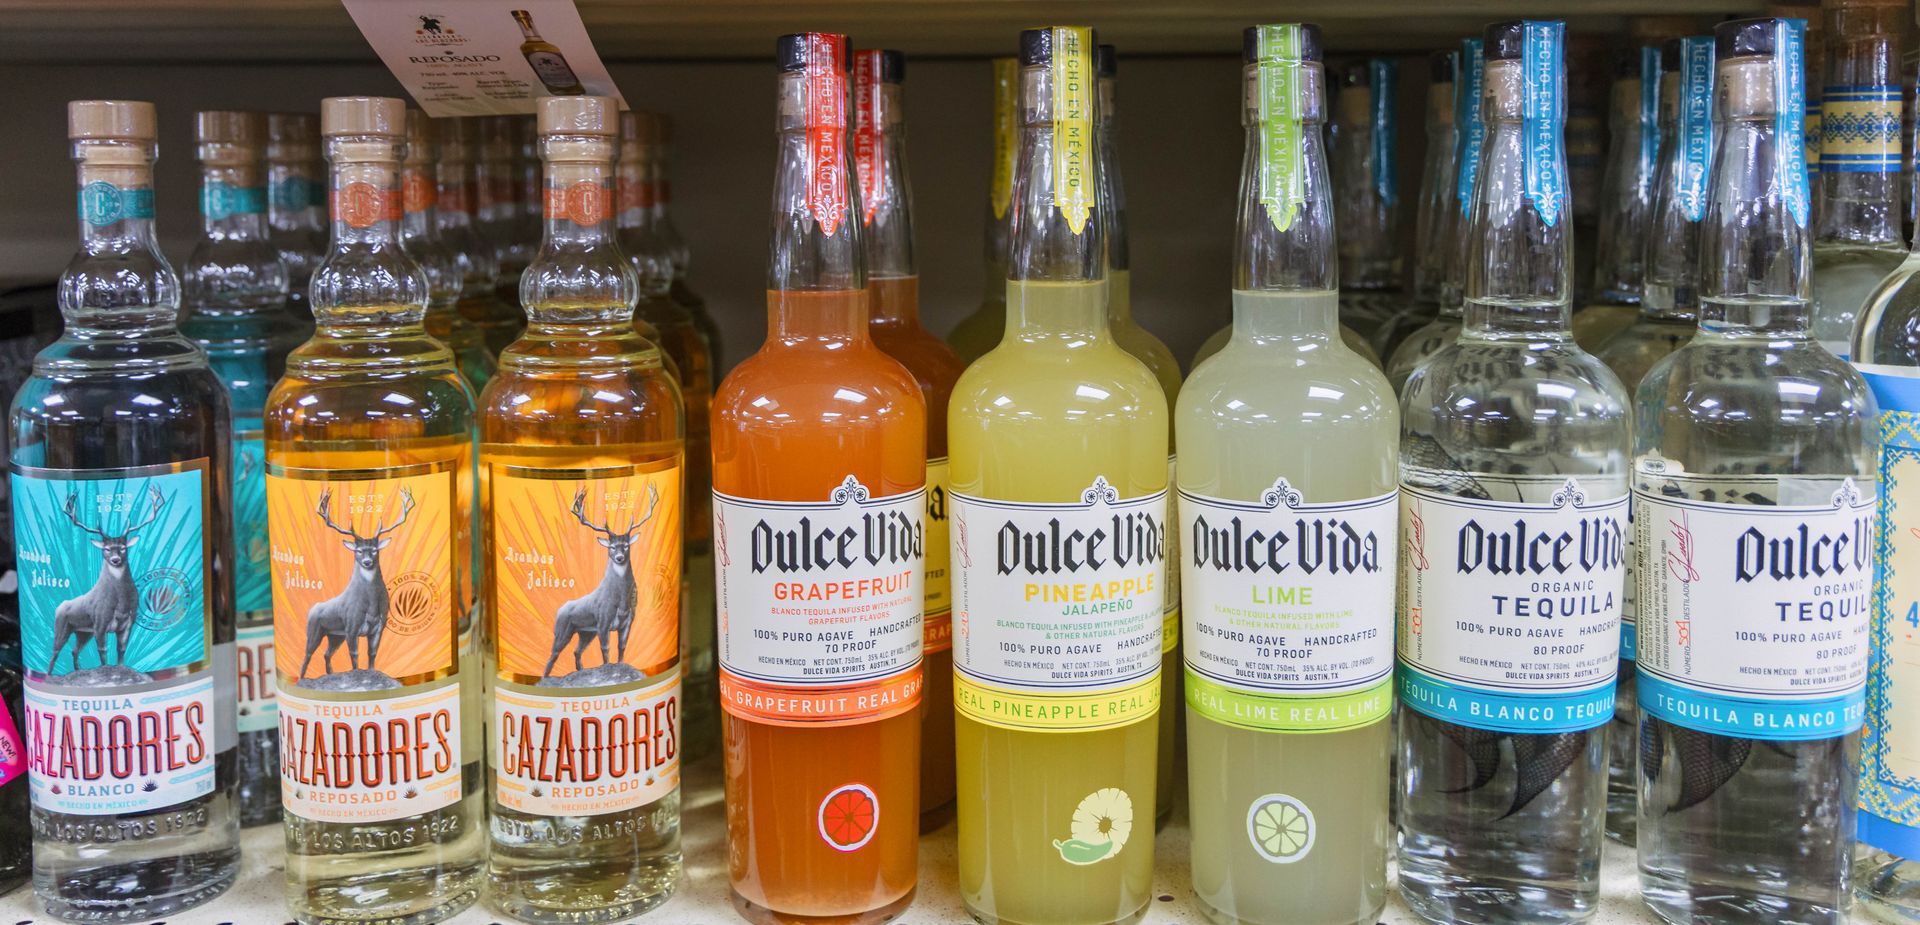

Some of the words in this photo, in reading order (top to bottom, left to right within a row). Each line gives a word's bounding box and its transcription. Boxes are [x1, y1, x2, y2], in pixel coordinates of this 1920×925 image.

[409, 55, 500, 63] REPOSADO
[1539, 27, 1550, 83] HECHO
[1068, 38, 1078, 92] HECHO
[1692, 44, 1707, 94] HECHO
[1068, 100, 1079, 119] EN
[1272, 95, 1284, 116] EN
[1539, 93, 1550, 111] EN
[1692, 100, 1704, 121] EN
[1792, 92, 1800, 115] EN
[821, 104, 833, 125] EN
[1068, 127, 1081, 187] MÉXICO
[751, 516, 858, 574] Dulce
[862, 510, 922, 567] Vida
[997, 517, 1106, 576] Dulce
[1193, 514, 1290, 575] Dulce
[1295, 518, 1380, 575] Vida
[1457, 518, 1573, 575] Dulce
[1736, 522, 1849, 584] Dulce
[774, 571, 912, 601] GRAPEFRUIT
[1025, 572, 1154, 602] PINEAPPLE
[1252, 584, 1313, 606] LIME
[1531, 580, 1594, 593] ORGANIC
[1814, 580, 1863, 596] ORGANIC
[771, 607, 801, 615] BLANCO
[803, 607, 836, 616] TEQUILA
[839, 605, 870, 614] INFUSED
[872, 602, 889, 612] WITH
[1062, 599, 1133, 616] JALAPEÑO
[1492, 591, 1613, 619] TEQUILA
[808, 616, 858, 626] GRAPEFRUIT
[860, 611, 890, 622] FLAVORS
[997, 619, 1024, 629] BLANCO
[1026, 622, 1058, 631] TEQUILA
[1060, 622, 1092, 631] INFUSED
[1094, 620, 1112, 630] WITH
[753, 629, 778, 641] 100%
[782, 632, 812, 641] PURO
[817, 631, 853, 641] AGAVE
[1052, 631, 1079, 640] OTHER
[1082, 628, 1116, 639] NATURAL
[1196, 621, 1214, 636] 100%
[1218, 629, 1244, 642] PURO
[1249, 635, 1286, 646] AGAVE
[1304, 628, 1377, 647] HANDCRAFTED
[1456, 620, 1484, 634] 100%
[1489, 626, 1522, 637] PURO
[1527, 628, 1564, 638] AGAVE
[1735, 631, 1767, 642] 100%
[1773, 632, 1806, 643] PURO
[1810, 630, 1842, 643] AGAVE
[825, 644, 839, 653] 70
[843, 640, 877, 652] PROOF
[999, 641, 1025, 653] 100%
[1031, 645, 1061, 655] PURO
[1067, 643, 1102, 654] AGAVE
[1256, 647, 1271, 658] 70
[1274, 649, 1313, 658] PROOF
[1533, 645, 1547, 655] 80
[1551, 643, 1585, 655] PROOF
[1816, 648, 1829, 660] 80
[1832, 647, 1857, 658] PROOF
[758, 656, 775, 664] HECHO
[776, 657, 783, 665] EN
[813, 658, 825, 666] NET
[803, 666, 823, 675] DULCE
[825, 665, 840, 674] VIDA
[842, 664, 865, 674] SPIRITS
[1004, 659, 1022, 668] HECHO
[1023, 661, 1031, 669] EN
[1062, 662, 1072, 670] NET
[1245, 661, 1256, 669] NET
[1257, 662, 1275, 671] CONT.
[1277, 664, 1296, 672] 750mL
[1303, 664, 1314, 672] 35%
[1459, 655, 1479, 666] HECHO
[1480, 658, 1488, 666] EN
[1489, 657, 1512, 669] MÉXICO
[1520, 662, 1532, 670] NET
[1051, 670, 1072, 679] DULCE
[1073, 670, 1088, 678] VIDA
[1090, 668, 1113, 677] SPIRITS
[1236, 668, 1255, 679] DULCE
[1256, 671, 1272, 679] VIDA
[1274, 672, 1299, 681] SPIRITS
[1331, 671, 1339, 679] TX
[1505, 671, 1527, 679] DULCE
[1529, 671, 1544, 679] VIDA
[1546, 670, 1570, 679] SPIRITS
[1739, 666, 1762, 675] HECHO
[1763, 667, 1772, 676] EN
[1773, 666, 1797, 676] MÉXICO
[1790, 677, 1811, 686] DULCE
[62, 698, 133, 713] TEQUILA
[561, 697, 630, 714] TEQUILA
[737, 691, 847, 713] GRAPEFRUIT
[857, 689, 898, 710] REAL
[1194, 688, 1226, 713] REAL
[1235, 702, 1279, 721] LIME
[1290, 705, 1340, 721] REAL
[1348, 696, 1381, 718] LIME
[1400, 676, 1457, 711] TEQUILA
[1470, 701, 1554, 721] BLANCO
[314, 705, 383, 719] TEQUILA
[993, 700, 1099, 719] PINEAPPLE
[1109, 697, 1144, 715] REAL
[1657, 693, 1739, 725] TEQUILA
[1754, 711, 1835, 728] BLANCO
[26, 701, 206, 781] CAZADORES
[279, 708, 451, 789] CAZADORES
[503, 696, 676, 783] CAZADORES
[68, 783, 134, 797] BLANCO
[310, 790, 397, 804] REPOSADO
[552, 779, 639, 798] REPOSADO
[352, 828, 415, 849] ALTOS
